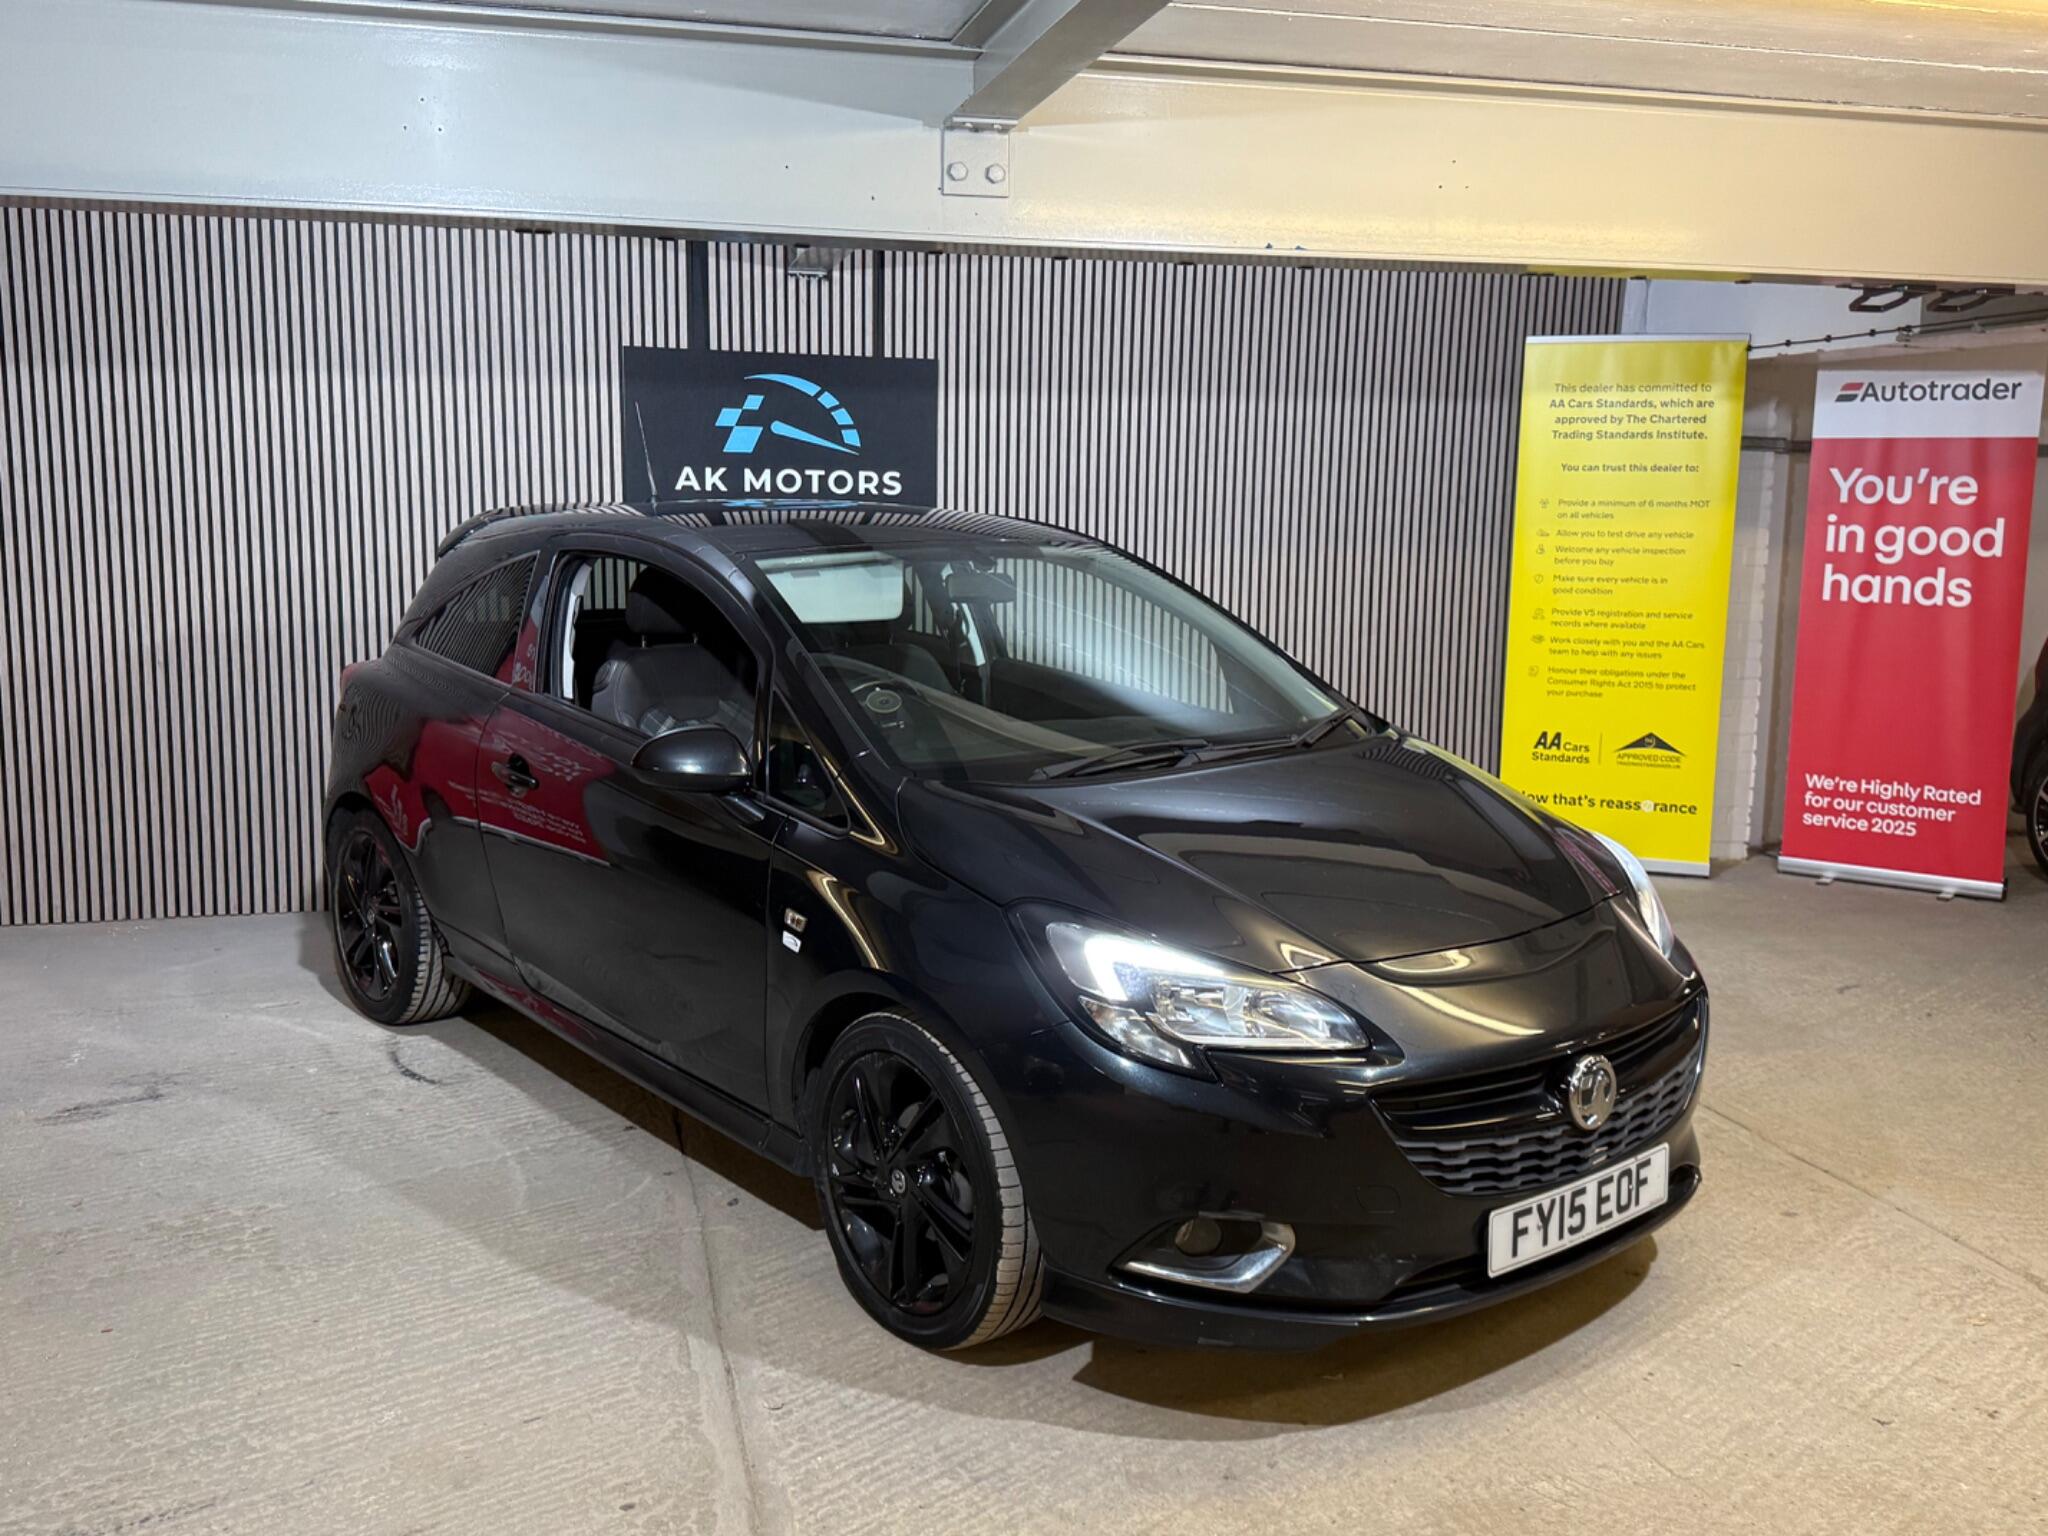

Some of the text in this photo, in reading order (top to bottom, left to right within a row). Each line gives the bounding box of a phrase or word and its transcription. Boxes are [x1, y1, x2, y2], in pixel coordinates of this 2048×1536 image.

[1555, 383, 1712, 393] This dealer has committed to
[1860, 378, 2022, 402] Autotrader
[1549, 400, 1565, 408] AA
[1568, 399, 1593, 408] Cars
[1596, 399, 1657, 409] Standards,
[1660, 399, 1694, 408] which
[1555, 414, 1707, 425] approved by The Chartered
[1552, 430, 1708, 441] Trading Standards Institute.
[1561, 463, 1579, 472] You
[1602, 464, 1626, 472] trust
[1629, 463, 1648, 472] this
[1650, 464, 1683, 472] dealer
[1685, 464, 1699, 472] to:
[675, 466, 903, 496] AK MOTORS
[1829, 467, 1978, 506] You're
[1558, 499, 1588, 507] Provide
[1656, 500, 1688, 508] months
[1690, 500, 1711, 508] MOT
[1556, 529, 1579, 537] Allow
[1826, 514, 2005, 564] in good
[1612, 546, 1640, 554] vehicle
[1643, 547, 1686, 555] inspection
[1554, 557, 1581, 565] before
[1599, 558, 1614, 566] buy
[1553, 574, 1575, 582] Make
[1596, 576, 1618, 584] every
[1621, 576, 1648, 584] vehicle
[1553, 586, 1613, 595] good condition
[1822, 563, 1972, 607] hands
[1552, 608, 1582, 616] Provide
[1597, 609, 1644, 619] registration
[1646, 610, 1661, 618] and
[1551, 620, 1581, 628] records
[1573, 637, 1600, 646] closely
[1603, 638, 1620, 646] with
[1657, 640, 1670, 648] the
[1686, 641, 1705, 649] Cars
[1581, 649, 1598, 658] help
[1620, 651, 1634, 659] any
[1548, 667, 1577, 675] Honour
[1580, 667, 1597, 675] their
[1600, 668, 1644, 678] obligations
[1647, 670, 1670, 678] under
[1547, 678, 1588, 686] Consumer
[1590, 679, 1615, 688] Rights
[1617, 680, 1631, 688] Act
[1666, 683, 1696, 691] protect
[1547, 689, 1603, 698] your purchase
[1534, 731, 1589, 753] AA Cars
[1532, 751, 1589, 764] Standards
[1617, 752, 1681, 763] APPROVED CODE
[1805, 773, 1981, 806] We're Highly Rated
[1553, 793, 1595, 807] that's
[1600, 798, 1697, 815] reassrance
[1804, 791, 1956, 822] for our customer
[1802, 812, 1916, 837] service 2025
[1511, 1158, 1652, 1258] FY15 EOF
